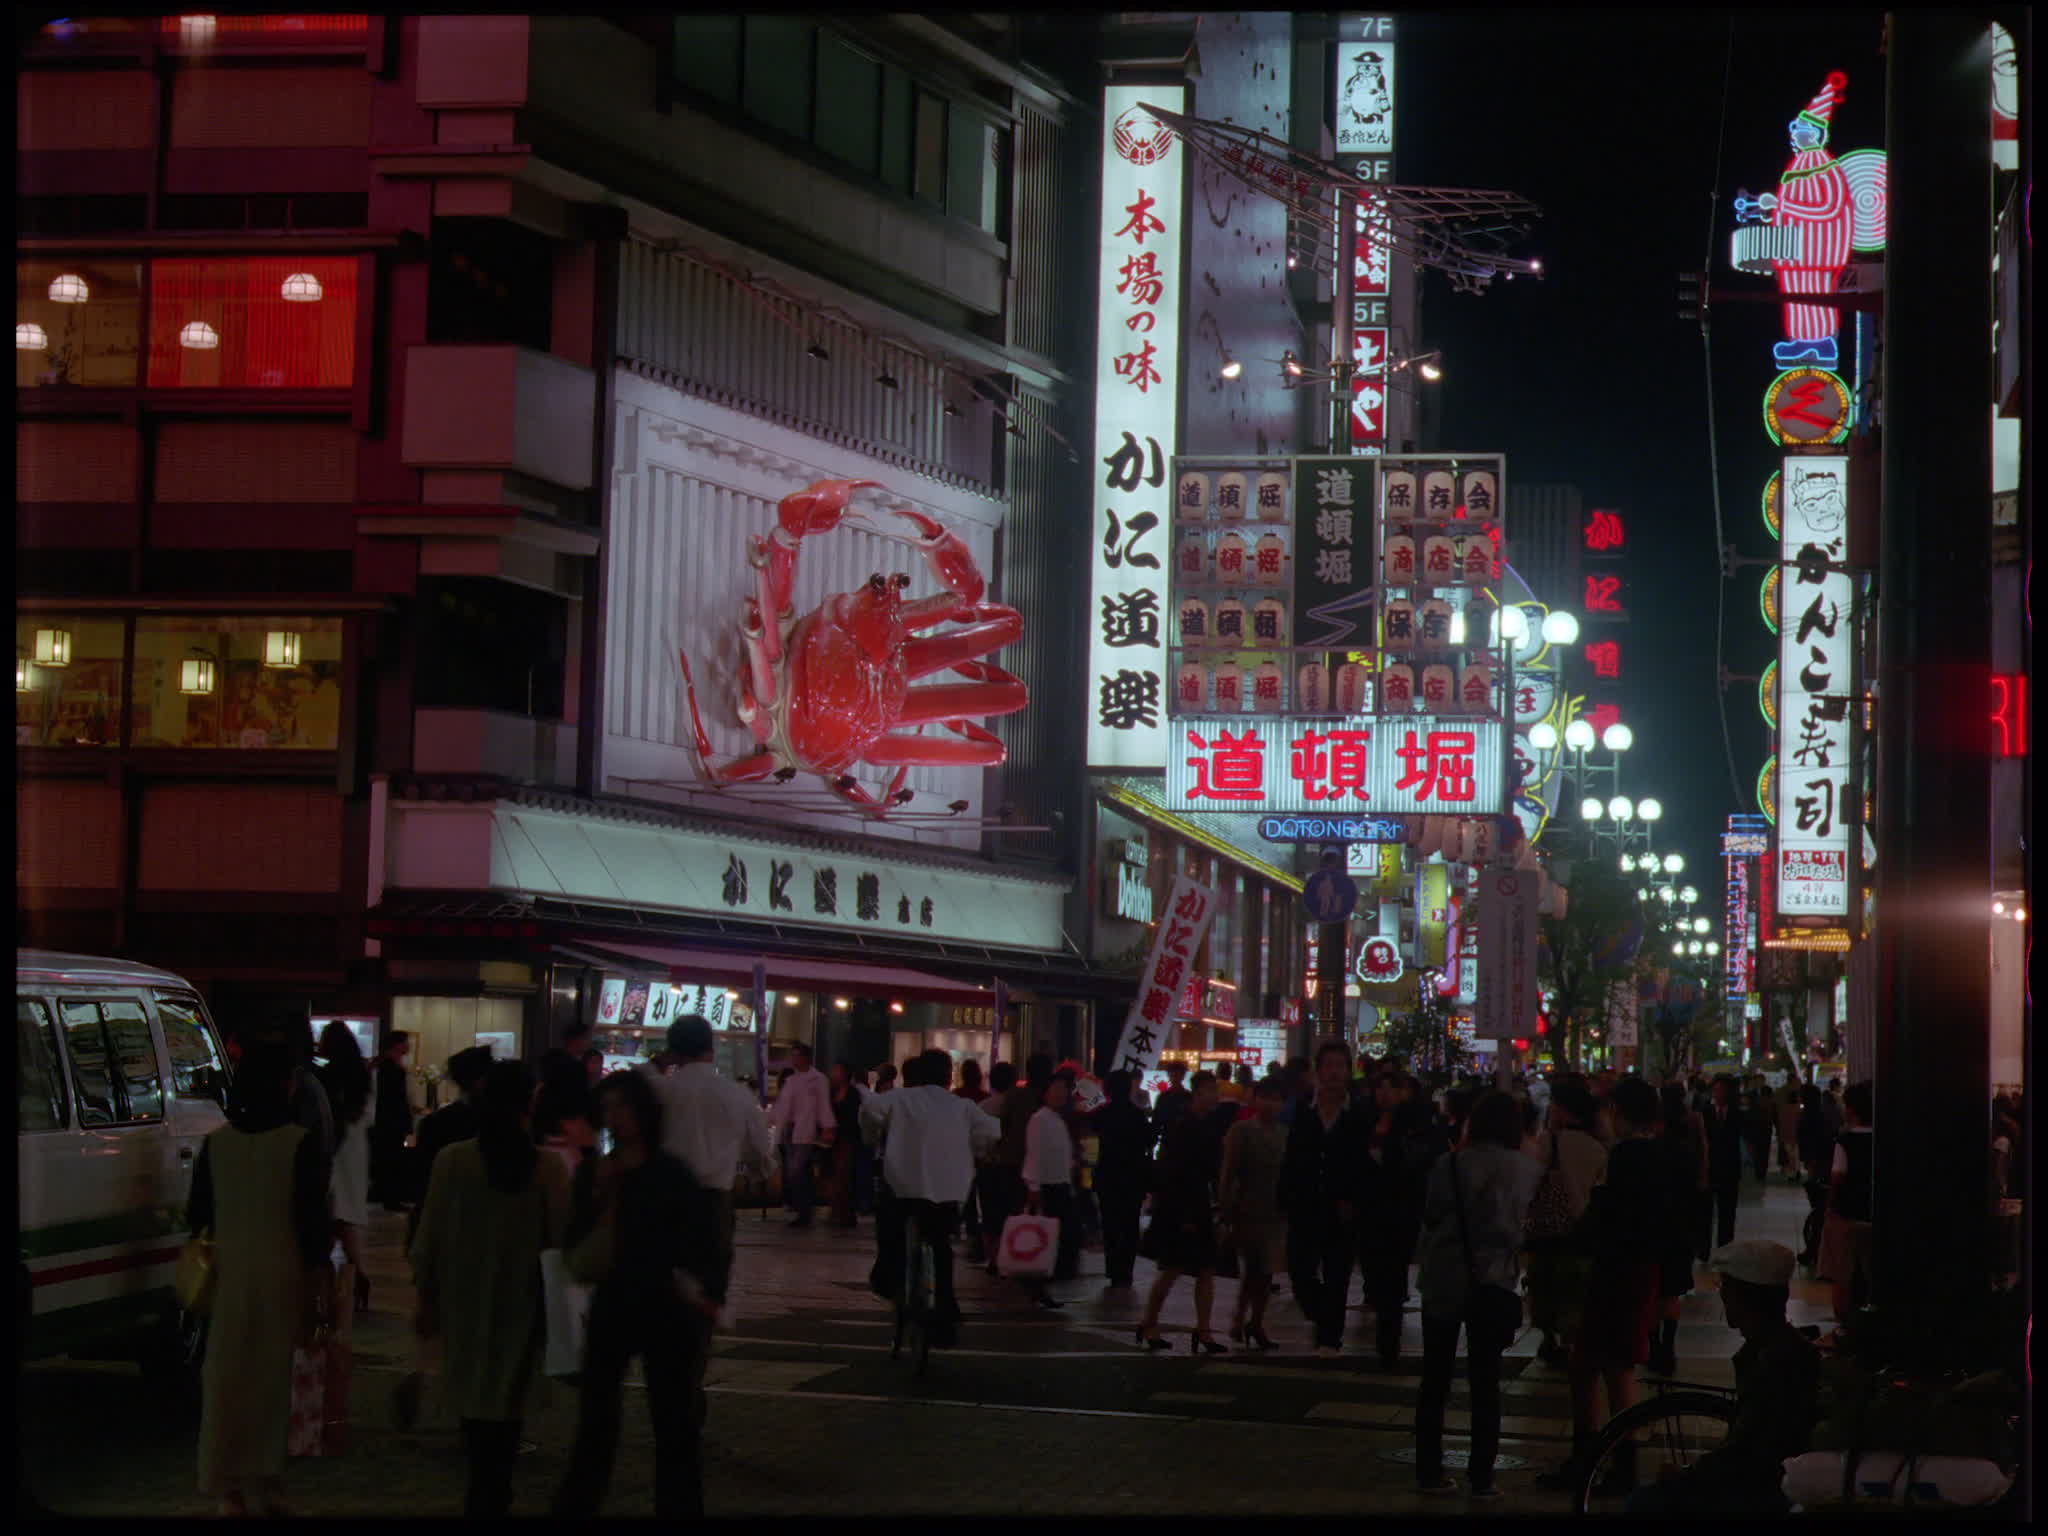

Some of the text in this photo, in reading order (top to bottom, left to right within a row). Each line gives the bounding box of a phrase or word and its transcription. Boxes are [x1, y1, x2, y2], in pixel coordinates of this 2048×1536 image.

[1360, 18, 1392, 37] 7F
[1355, 160, 1390, 180] 6F
[1113, 189, 1166, 393] 本場の味
[1354, 302, 1386, 322] 5F
[1388, 481, 1491, 510] 保存会
[1314, 467, 1355, 585] 道頓堀
[1392, 545, 1489, 573] 商店会
[1385, 674, 1489, 701] 商店会
[1794, 536, 1843, 838] がんこ寿司
[1185, 729, 1477, 802] 道頓堀
